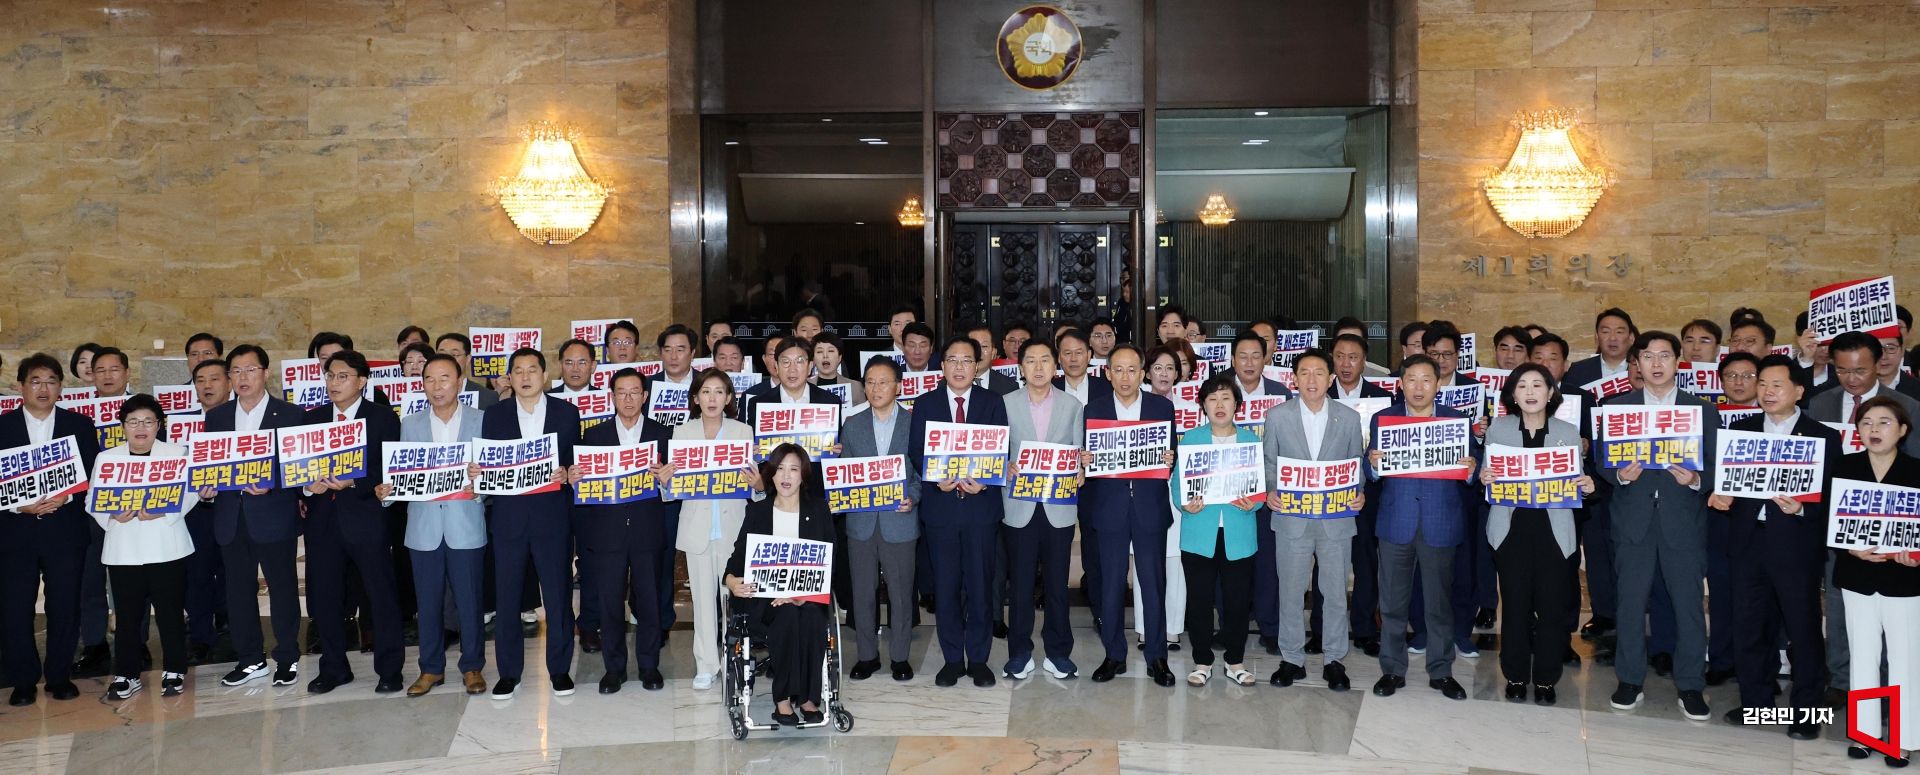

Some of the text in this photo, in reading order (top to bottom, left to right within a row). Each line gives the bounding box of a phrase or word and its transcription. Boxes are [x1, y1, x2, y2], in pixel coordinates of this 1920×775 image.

[1462, 253, 1633, 278] 제1회의장
[1811, 281, 1890, 320] 묻지마식 의회폭주
[1850, 302, 1893, 330] 협치파괴
[472, 333, 505, 353] 우기면
[285, 363, 321, 386] 우기면
[473, 357, 507, 377] 분노유발
[158, 390, 192, 411] 불법!
[578, 392, 611, 415] 무능!
[759, 409, 795, 432] 불법!
[1608, 412, 1649, 437] 불법!
[1655, 409, 1698, 433] 무능!
[193, 432, 272, 463] 불법! 무능!
[282, 421, 363, 457] 우기면 장땡?
[927, 429, 1006, 451] 우기면 장땡?
[1088, 425, 1167, 451] 묻지마식 의회폭주
[1381, 423, 1465, 450] 묻지마식 의회폭주
[0, 439, 71, 479] 폰의혹 배추투자
[389, 443, 465, 470] 스폰의혹 배추투자
[478, 436, 552, 468] 스폰의혹 배추투자
[577, 444, 654, 474] 불법! 무능!
[672, 443, 748, 469] 불법! 무능!
[1018, 448, 1054, 470] 우기면
[1089, 447, 1166, 472] 민주당식 협치파괴
[1381, 444, 1465, 471] 민주당식 협치파괴
[1490, 449, 1574, 477] 불법! 무능!
[1607, 440, 1699, 465] 부적격 김민석
[1723, 439, 1768, 463] 스폰의혹
[1770, 440, 1816, 464] 배추투자
[39, 463, 77, 495] 사퇴하라
[100, 458, 187, 483] 우기면 장땡?
[191, 459, 272, 491] 부적격 김민석
[284, 449, 364, 486] 분노유발 김민석
[479, 461, 553, 491] 김민석은 사퇴하라
[826, 457, 902, 486] 우기면 장땡?
[926, 456, 1004, 480] 분노유발 김민석
[1280, 461, 1357, 487] 우기면 장땡?
[1722, 467, 1814, 492] 김민석은 사퇴하라
[390, 469, 464, 496] 김민석은 사퇴하라
[577, 473, 655, 503] 부적격 김민석
[670, 472, 748, 497] 부적격 김민석
[1013, 476, 1054, 498] 분노유발
[1491, 479, 1578, 503] 부적격 김민석
[97, 488, 182, 511] 분노유발 김민석
[828, 482, 904, 511] 분노유발 김민석
[1281, 487, 1358, 514] 분노유발 김민석
[1837, 489, 1883, 514] 스폰의혹
[1835, 519, 1881, 545] 김민석은
[751, 543, 826, 566] 스폰의혹 배추투자
[751, 568, 824, 592] 김민석은 사퇴하라
